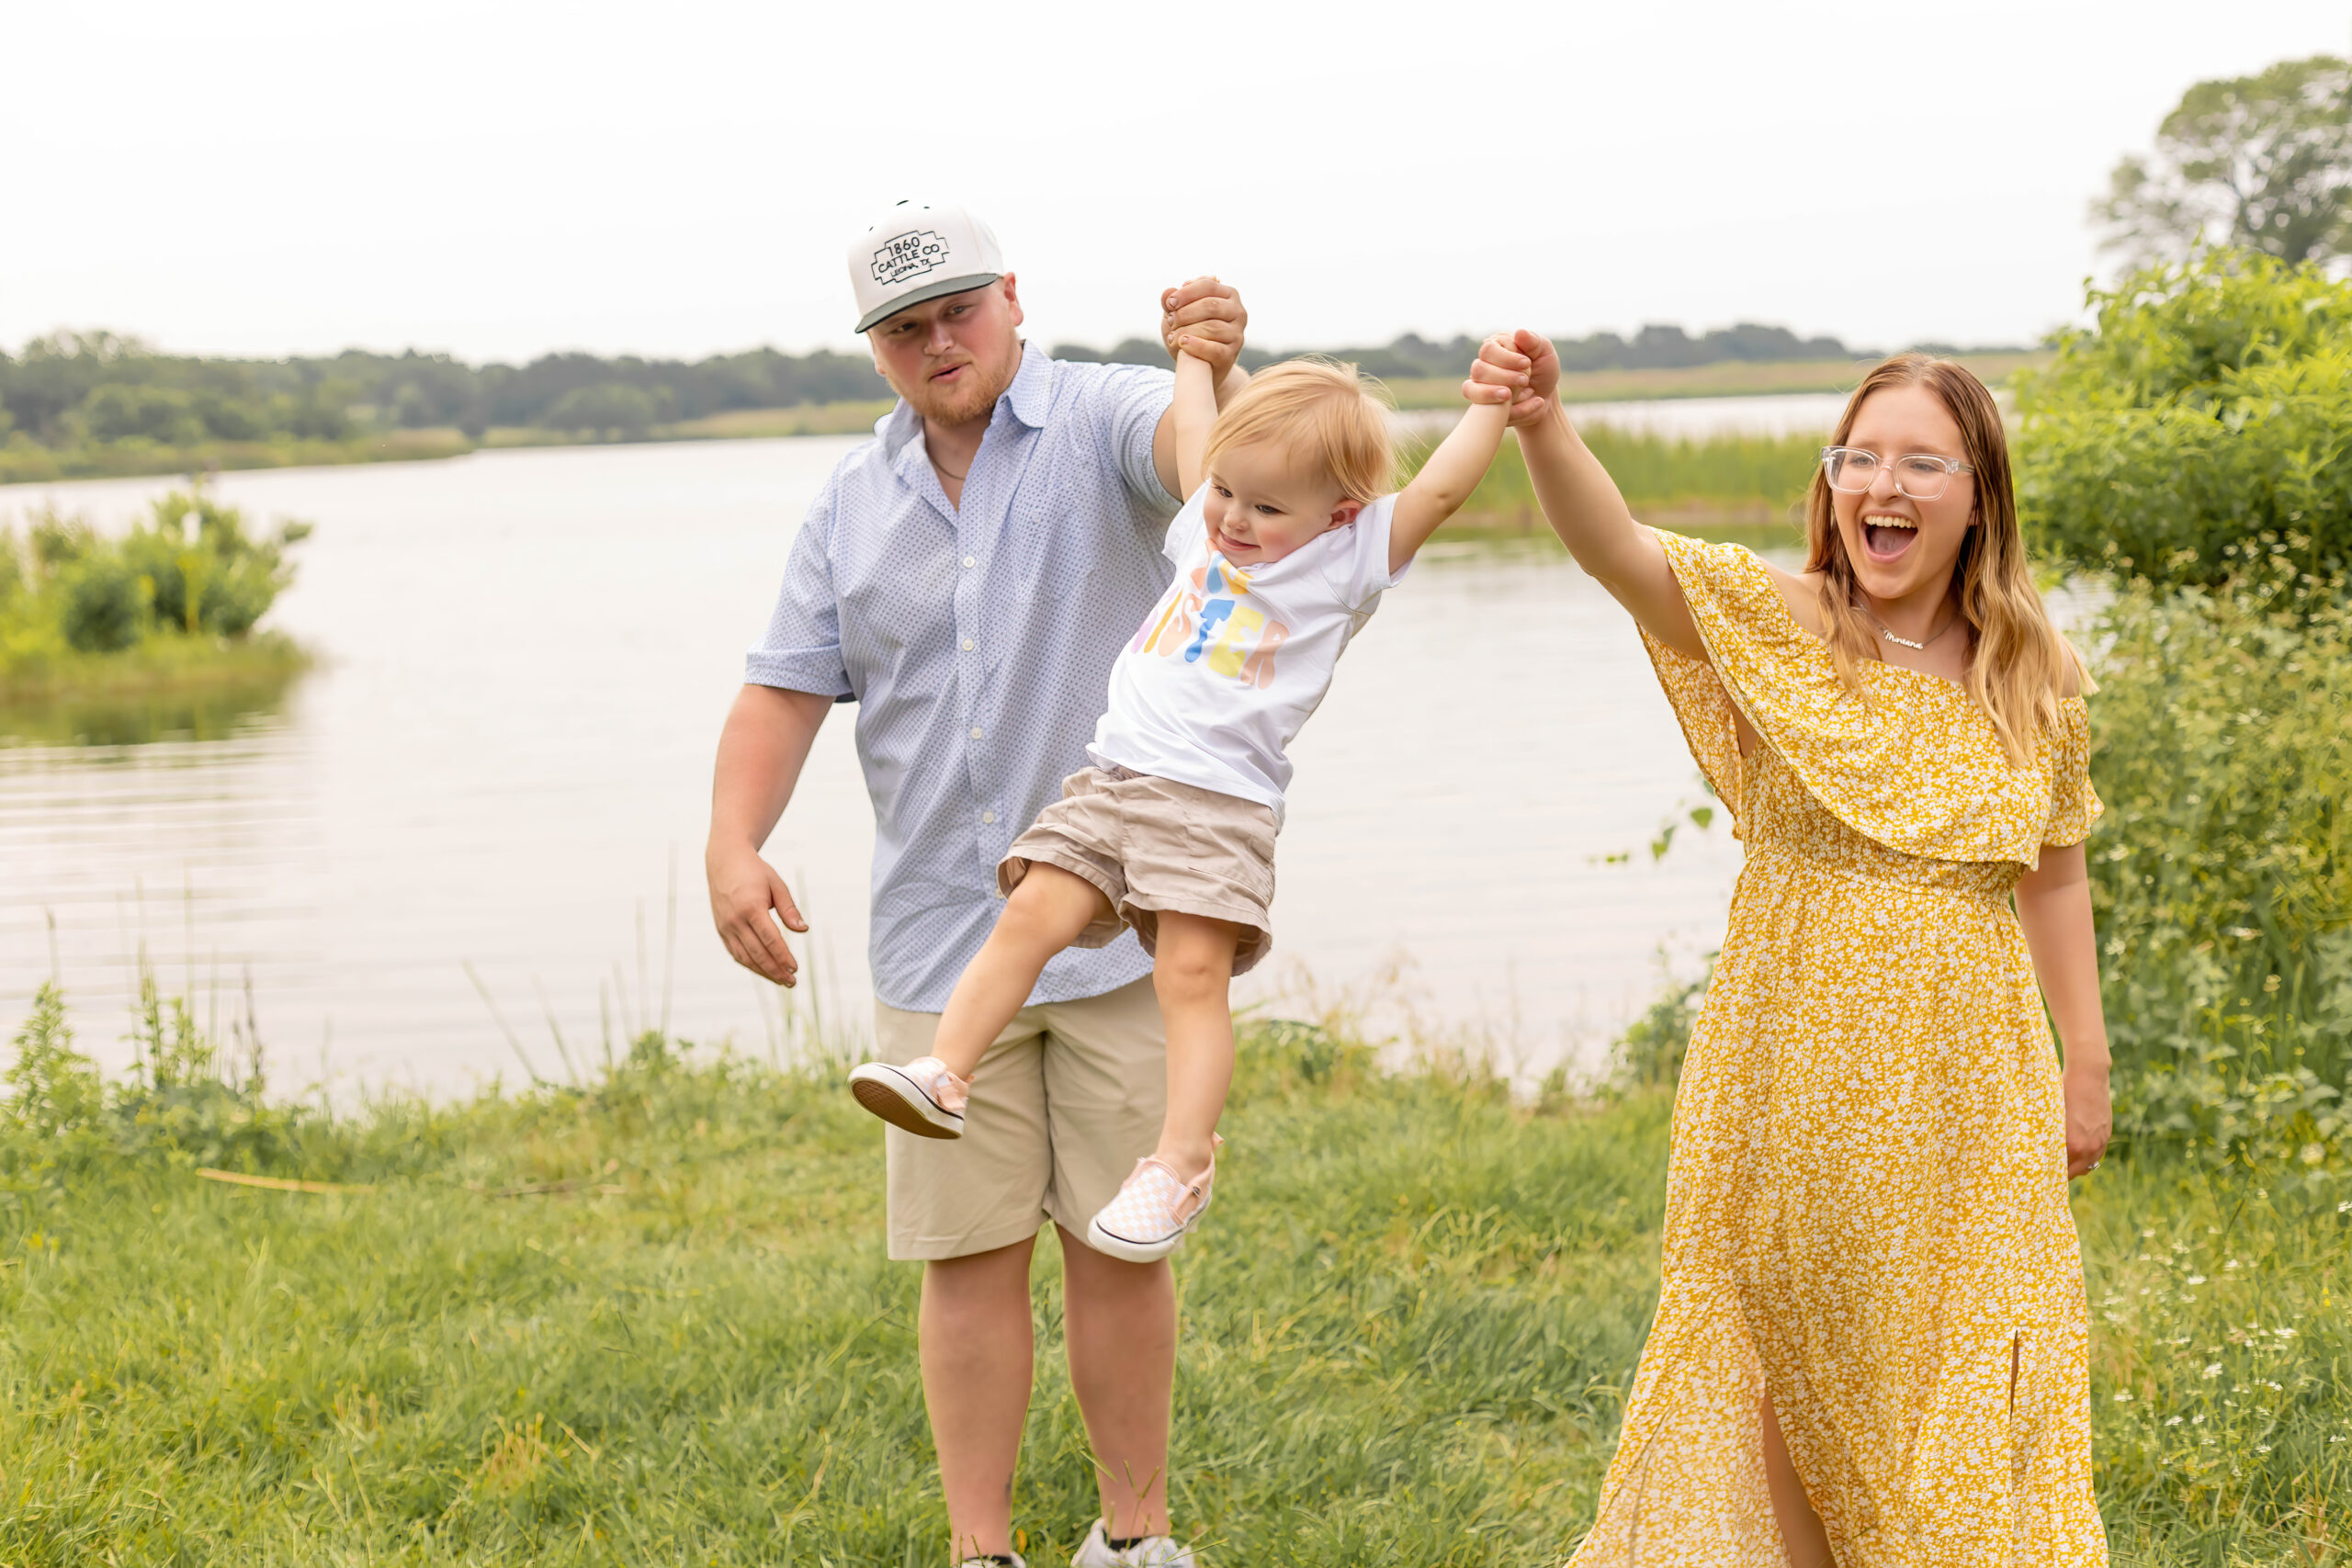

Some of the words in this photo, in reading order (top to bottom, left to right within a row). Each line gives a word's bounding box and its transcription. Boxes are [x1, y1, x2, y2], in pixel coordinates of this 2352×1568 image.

[878, 249, 920, 273] CATTLE
[922, 243, 940, 255] CO
[888, 237, 920, 256] 1860
